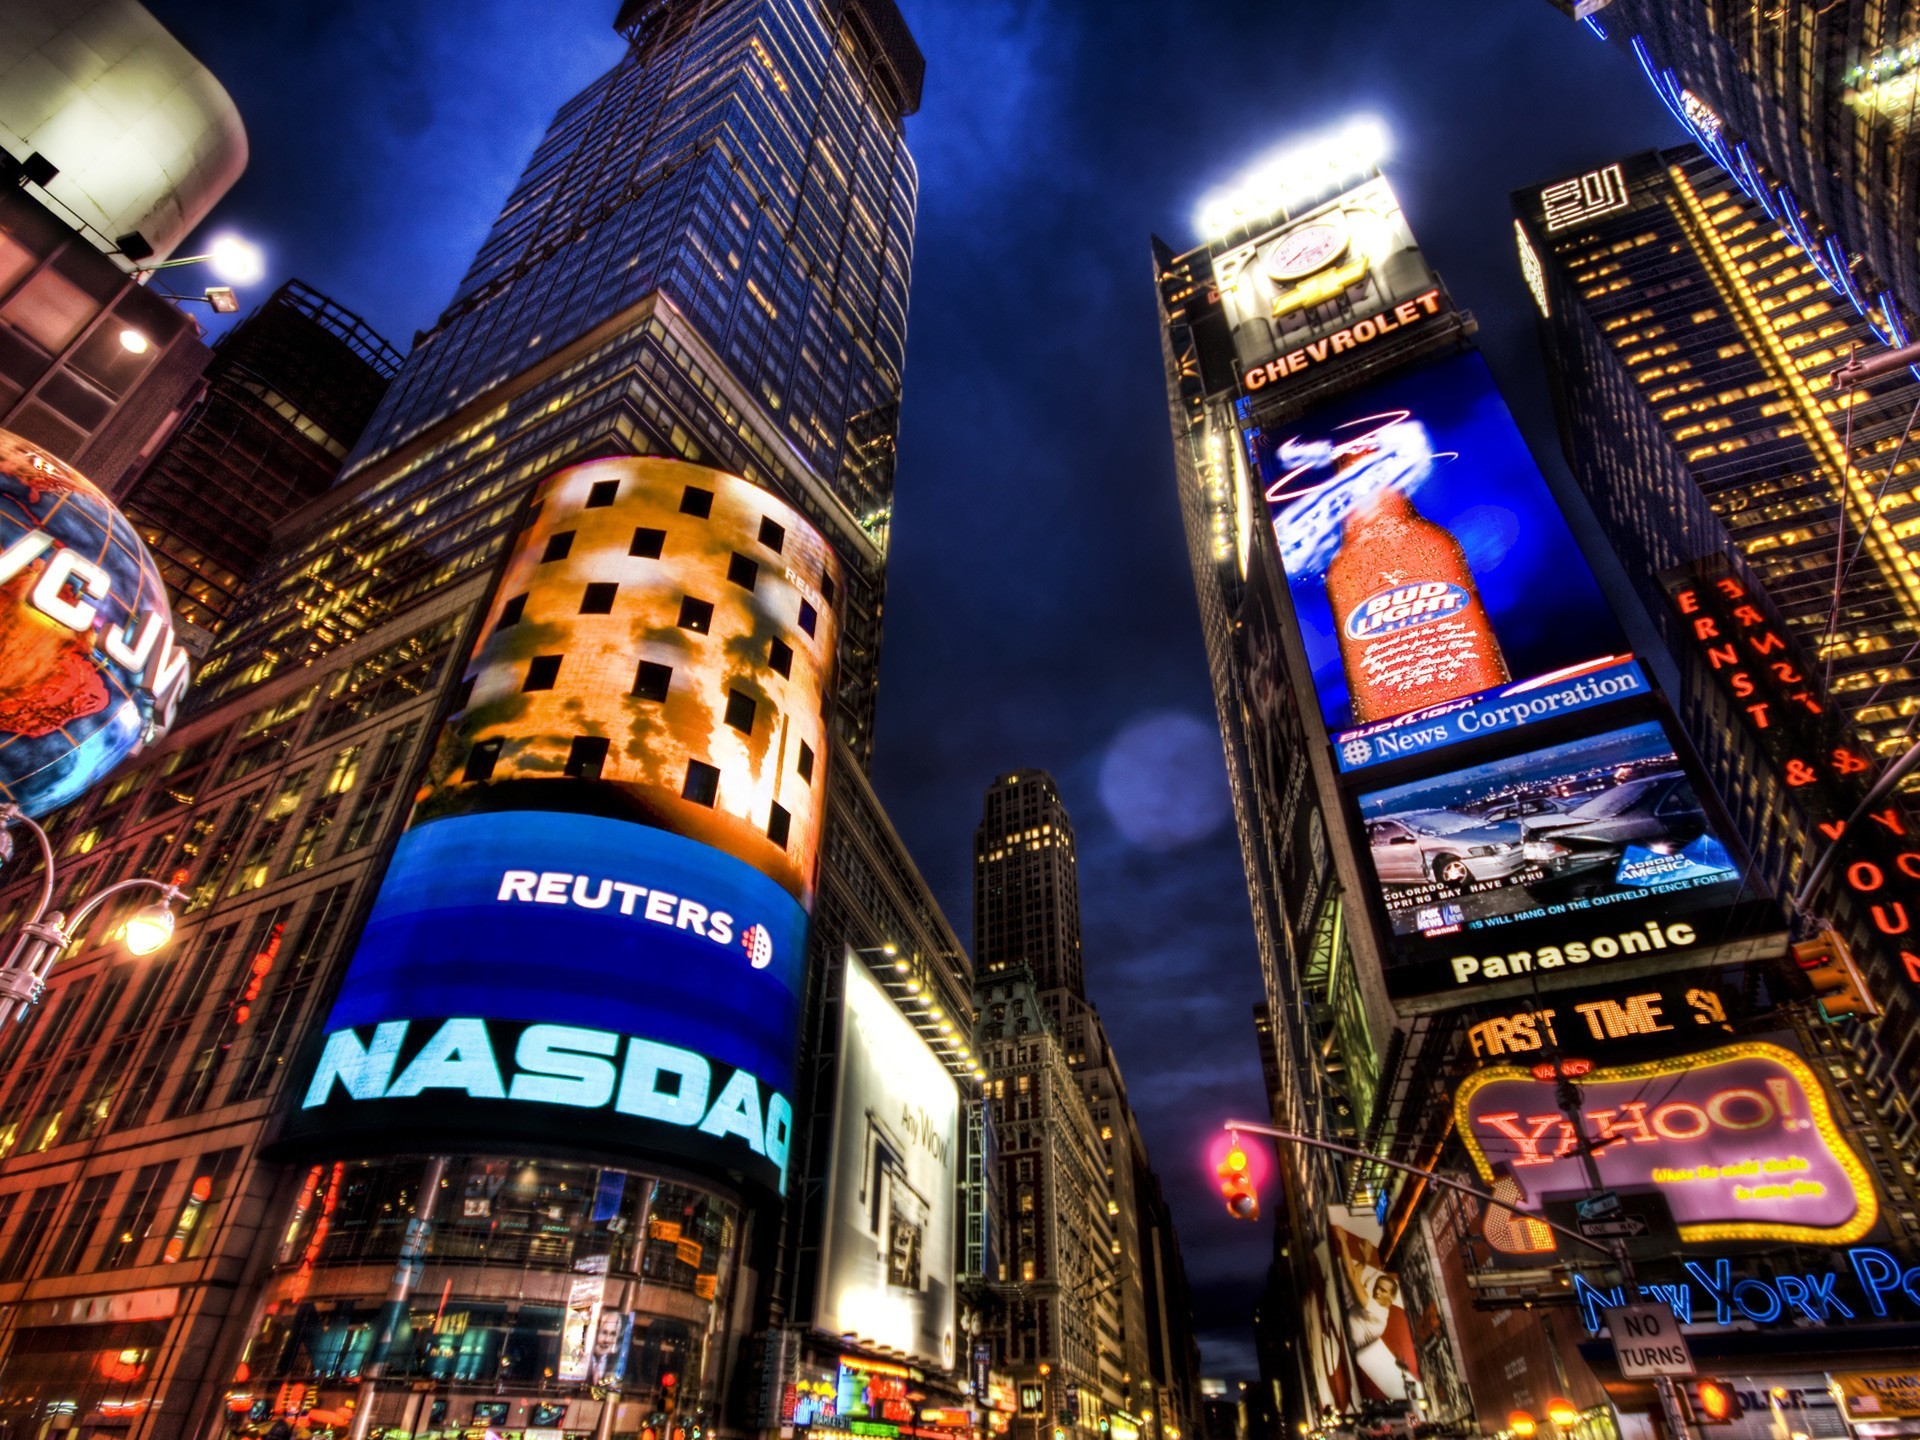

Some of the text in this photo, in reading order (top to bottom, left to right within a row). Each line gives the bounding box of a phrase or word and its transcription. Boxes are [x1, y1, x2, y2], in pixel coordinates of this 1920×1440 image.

[1244, 289, 1440, 391] CHEVROLET
[1358, 594, 1461, 636] LIGHT
[1366, 582, 1449, 615] BUD
[1678, 590, 1769, 729] ERNST
[1786, 759, 1817, 786] &
[1377, 671, 1639, 757] News Corporation
[1618, 858, 1697, 882] AMERICA
[1625, 853, 1685, 870] ACROSS
[1383, 883, 1449, 902] COLORADO.
[1438, 887, 1462, 900] MAY
[1470, 880, 1503, 893] HAVE
[1510, 871, 1545, 885] SPRU
[1485, 915, 1513, 927] WILL
[1514, 908, 1546, 921] HANG
[1548, 904, 1566, 914] ON
[1568, 899, 1591, 911] THE
[1592, 888, 1649, 906] OUTFIELD
[1651, 880, 1691, 895] FENCE
[1693, 875, 1719, 887] FOR
[497, 870, 734, 946] REUTERS
[1425, 924, 1459, 938] channel
[1451, 921, 1696, 983] Panasonic
[1468, 1008, 1558, 1058] FIRST
[1574, 992, 1675, 1040] TIME
[302, 1017, 794, 1198] NASDAQ
[1477, 1077, 1798, 1167] YAHOO!
[1589, 1221, 1638, 1233] ONE WAY
[1623, 1315, 1661, 1338] NO
[1621, 1345, 1687, 1368] TURNS
